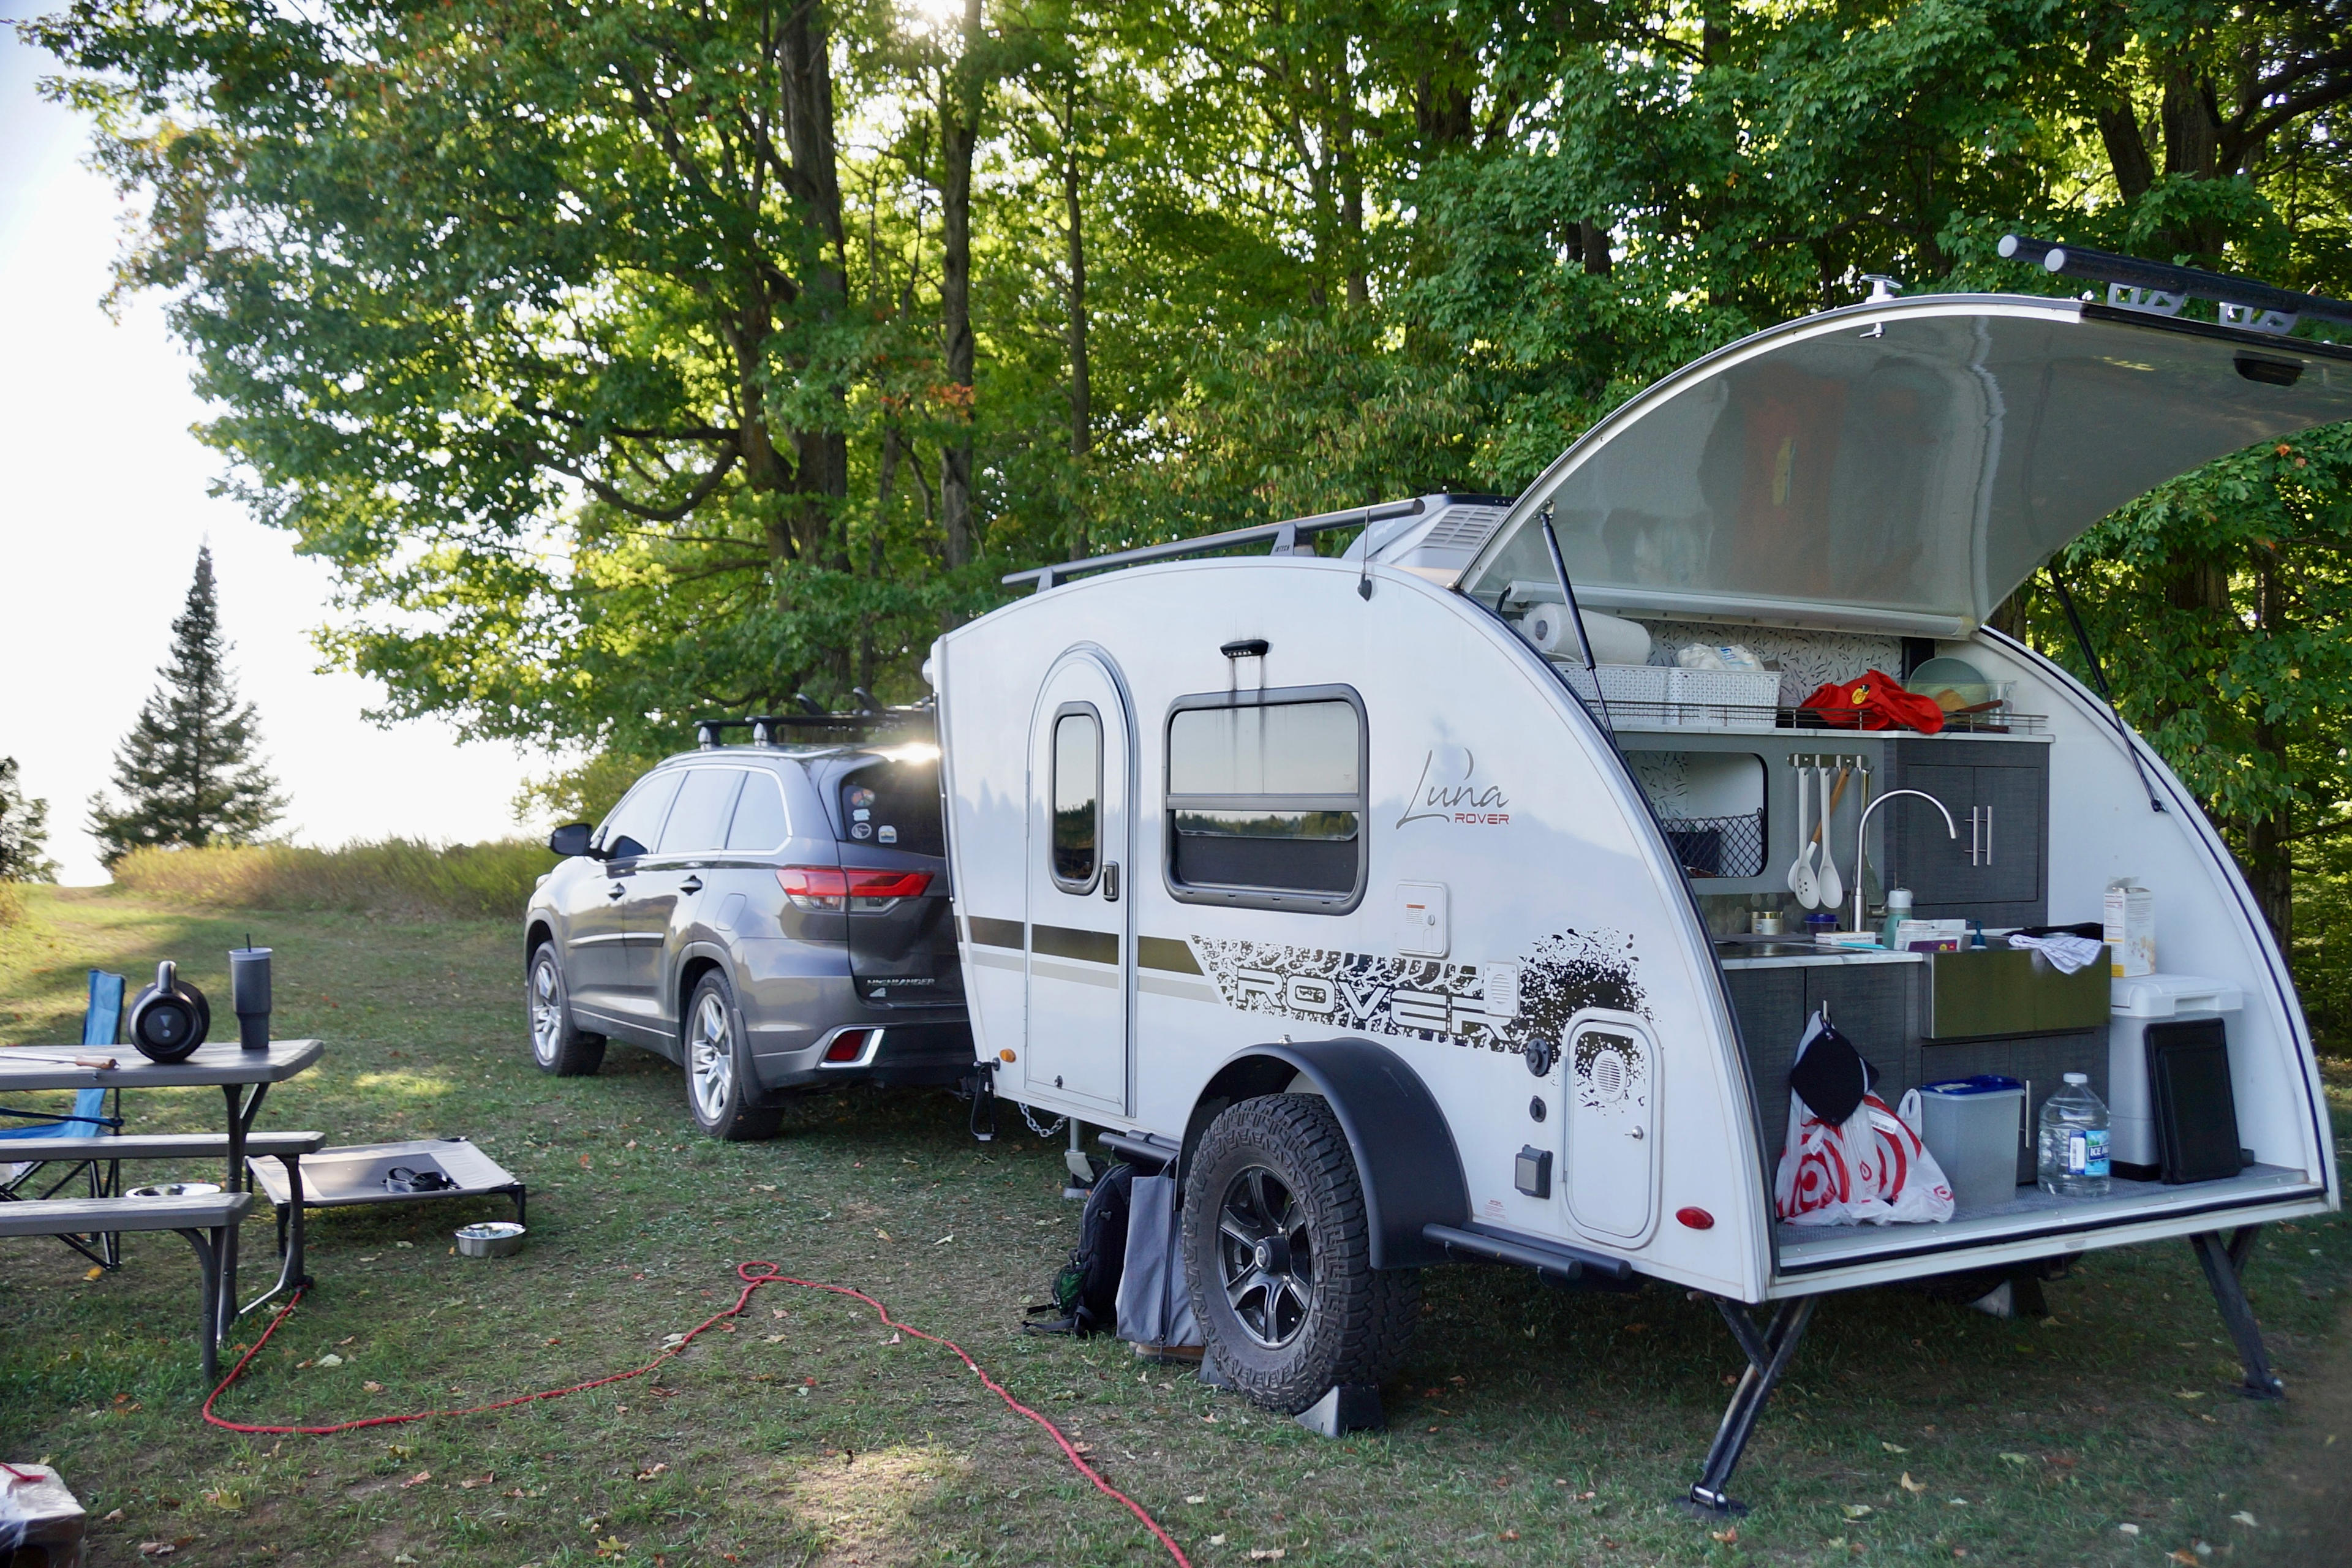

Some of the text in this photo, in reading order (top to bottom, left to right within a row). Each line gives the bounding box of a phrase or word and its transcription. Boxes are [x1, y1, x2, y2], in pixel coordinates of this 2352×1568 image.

[1395, 748, 1510, 830] Luna
[1454, 813, 1510, 825] ROVER
[1237, 968, 1512, 1041] ROVER
[2090, 1147, 2102, 1156] ICE
